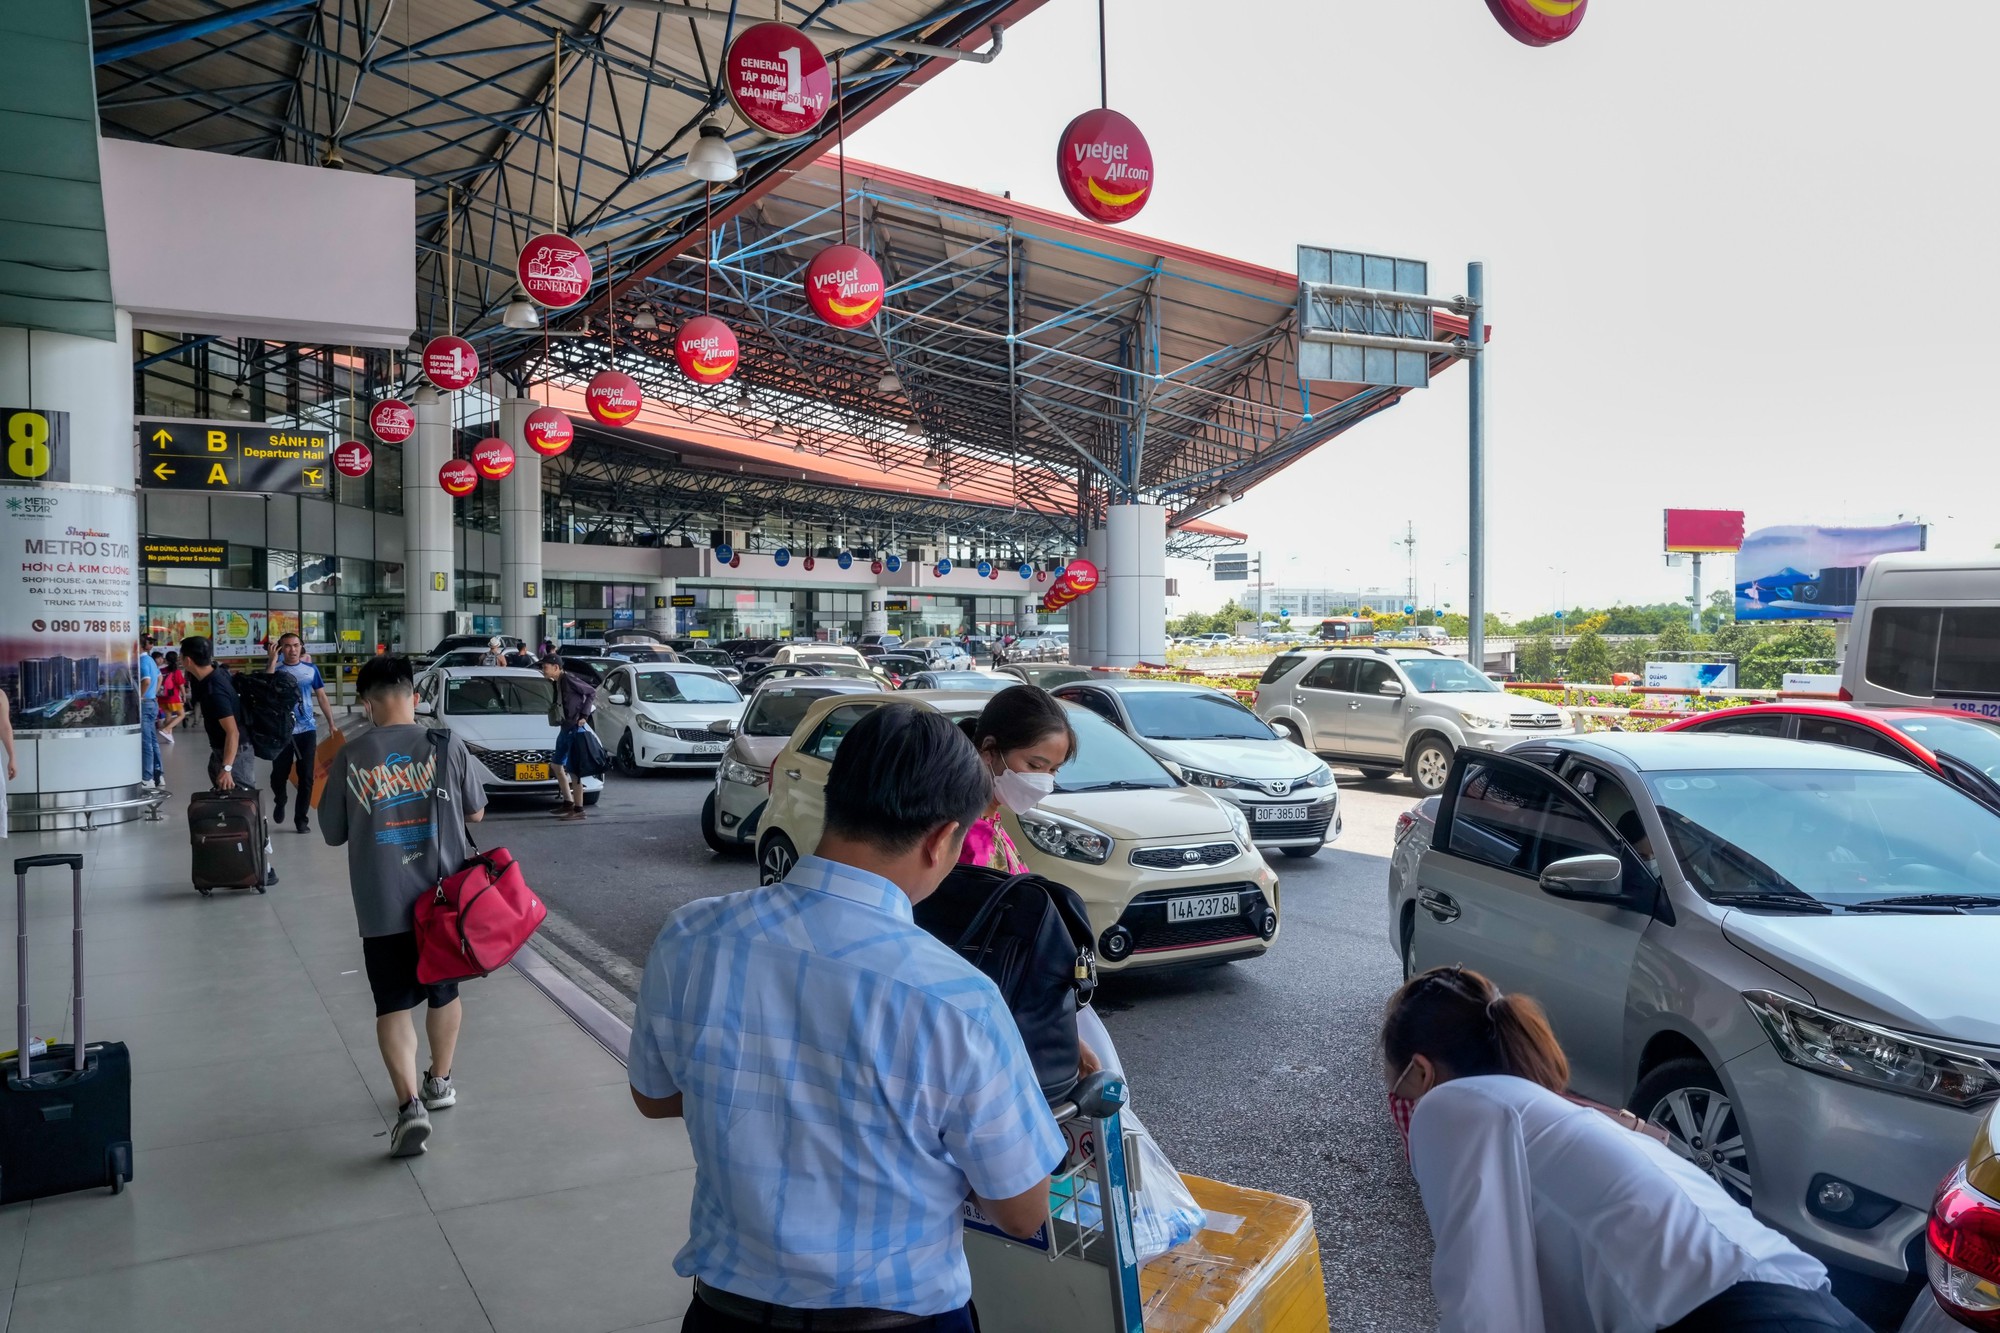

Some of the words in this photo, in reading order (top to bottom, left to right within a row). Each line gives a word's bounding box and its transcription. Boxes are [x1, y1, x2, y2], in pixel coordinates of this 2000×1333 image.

[741, 58, 786, 72] GENERALI
[741, 70, 758, 83] TẬP
[761, 73, 786, 87] ĐOÀN
[778, 46, 805, 114] 1
[741, 85, 761, 98] BẢO
[763, 87, 786, 102] HIỂM
[802, 96, 815, 109] TẠI
[528, 279, 582, 296] GENERALI
[376, 427, 410, 435] GENERALI
[8, 412, 50, 477] 8
[207, 430, 228, 452] B
[269, 432, 307, 447] SẢNH
[311, 438, 324, 448] ĐI
[244, 447, 300, 459] Departure
[303, 450, 325, 460] Hall
[207, 463, 229, 484] A
[24, 497, 58, 506] METRO
[25, 505, 50, 513] STAR
[65, 526, 110, 539] Shophouse
[25, 539, 97, 557] METRO
[100, 543, 130, 559] STAR
[22, 562, 53, 572] HƠN
[79, 564, 100, 574] KIM
[435, 572, 445, 591] 6
[29, 587, 46, 595] ĐẠI
[527, 583, 535, 597] 5
[78, 599, 96, 607] TÂM
[873, 602, 880, 610] 3
[51, 619, 80, 633] 090
[84, 620, 107, 633] 789
[109, 620, 121, 633] 65
[1952, 703, 2000, 718] 18B-02
[526, 764, 540, 772] 15E
[519, 771, 546, 780] 004.96
[1257, 808, 1306, 820] 30F-385.05
[1184, 852, 1200, 861] KIA
[1171, 896, 1237, 920] 14A-237.84
